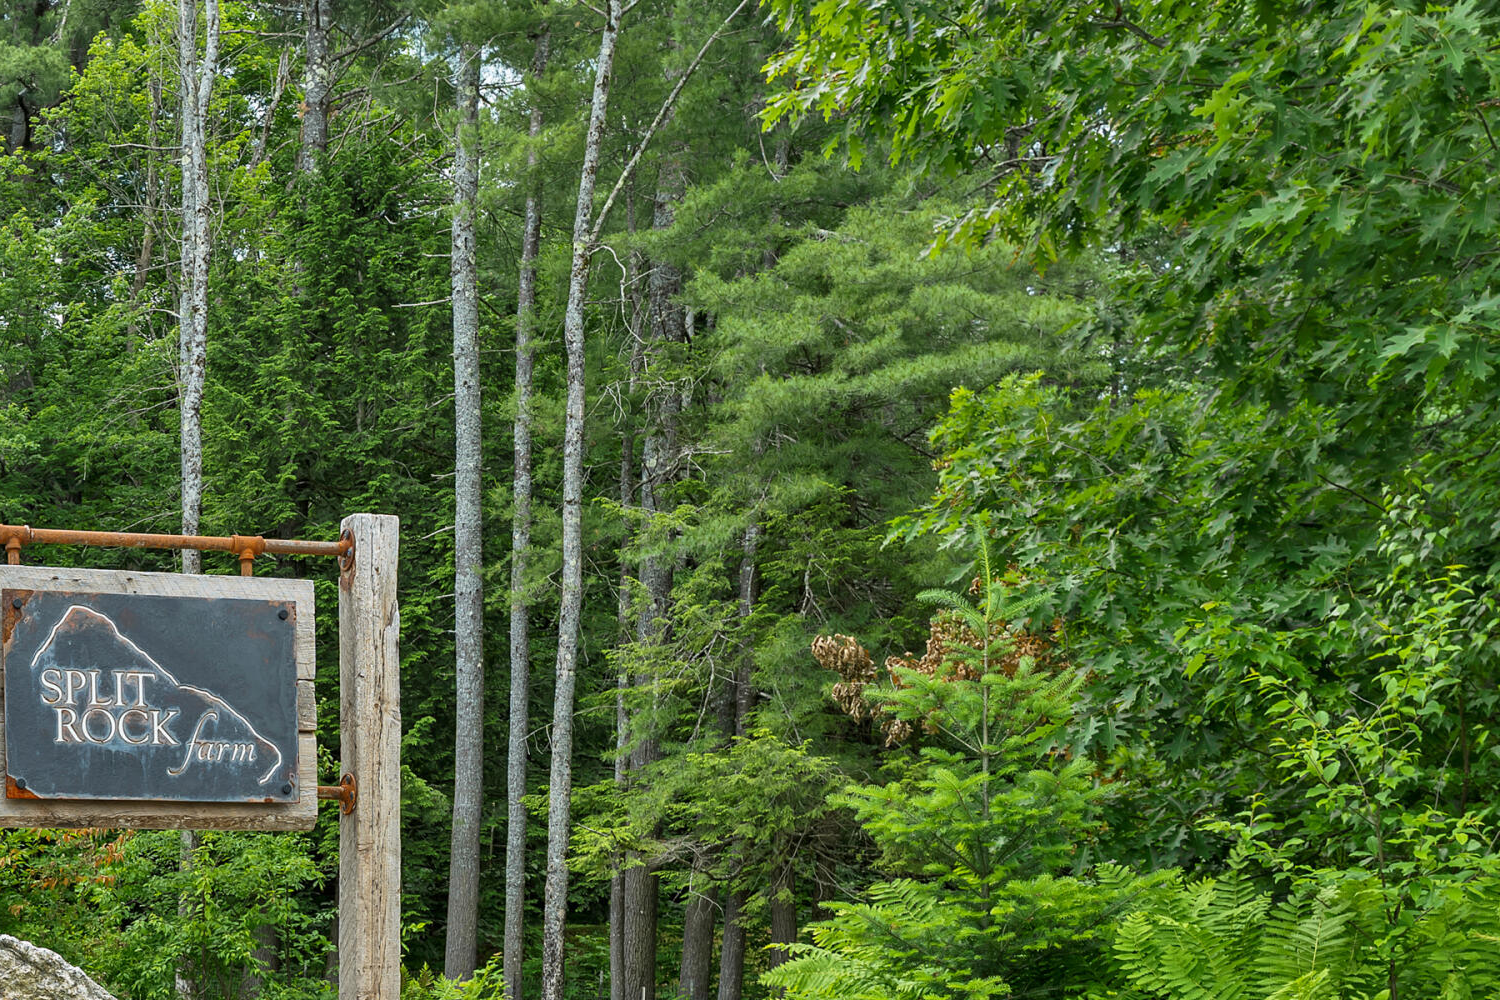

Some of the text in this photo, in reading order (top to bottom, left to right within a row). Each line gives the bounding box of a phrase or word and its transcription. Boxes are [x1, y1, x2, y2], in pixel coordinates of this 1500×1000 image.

[40, 669, 156, 707] SPLIT
[54, 706, 180, 745] ROCK
[167, 711, 256, 776] farm
